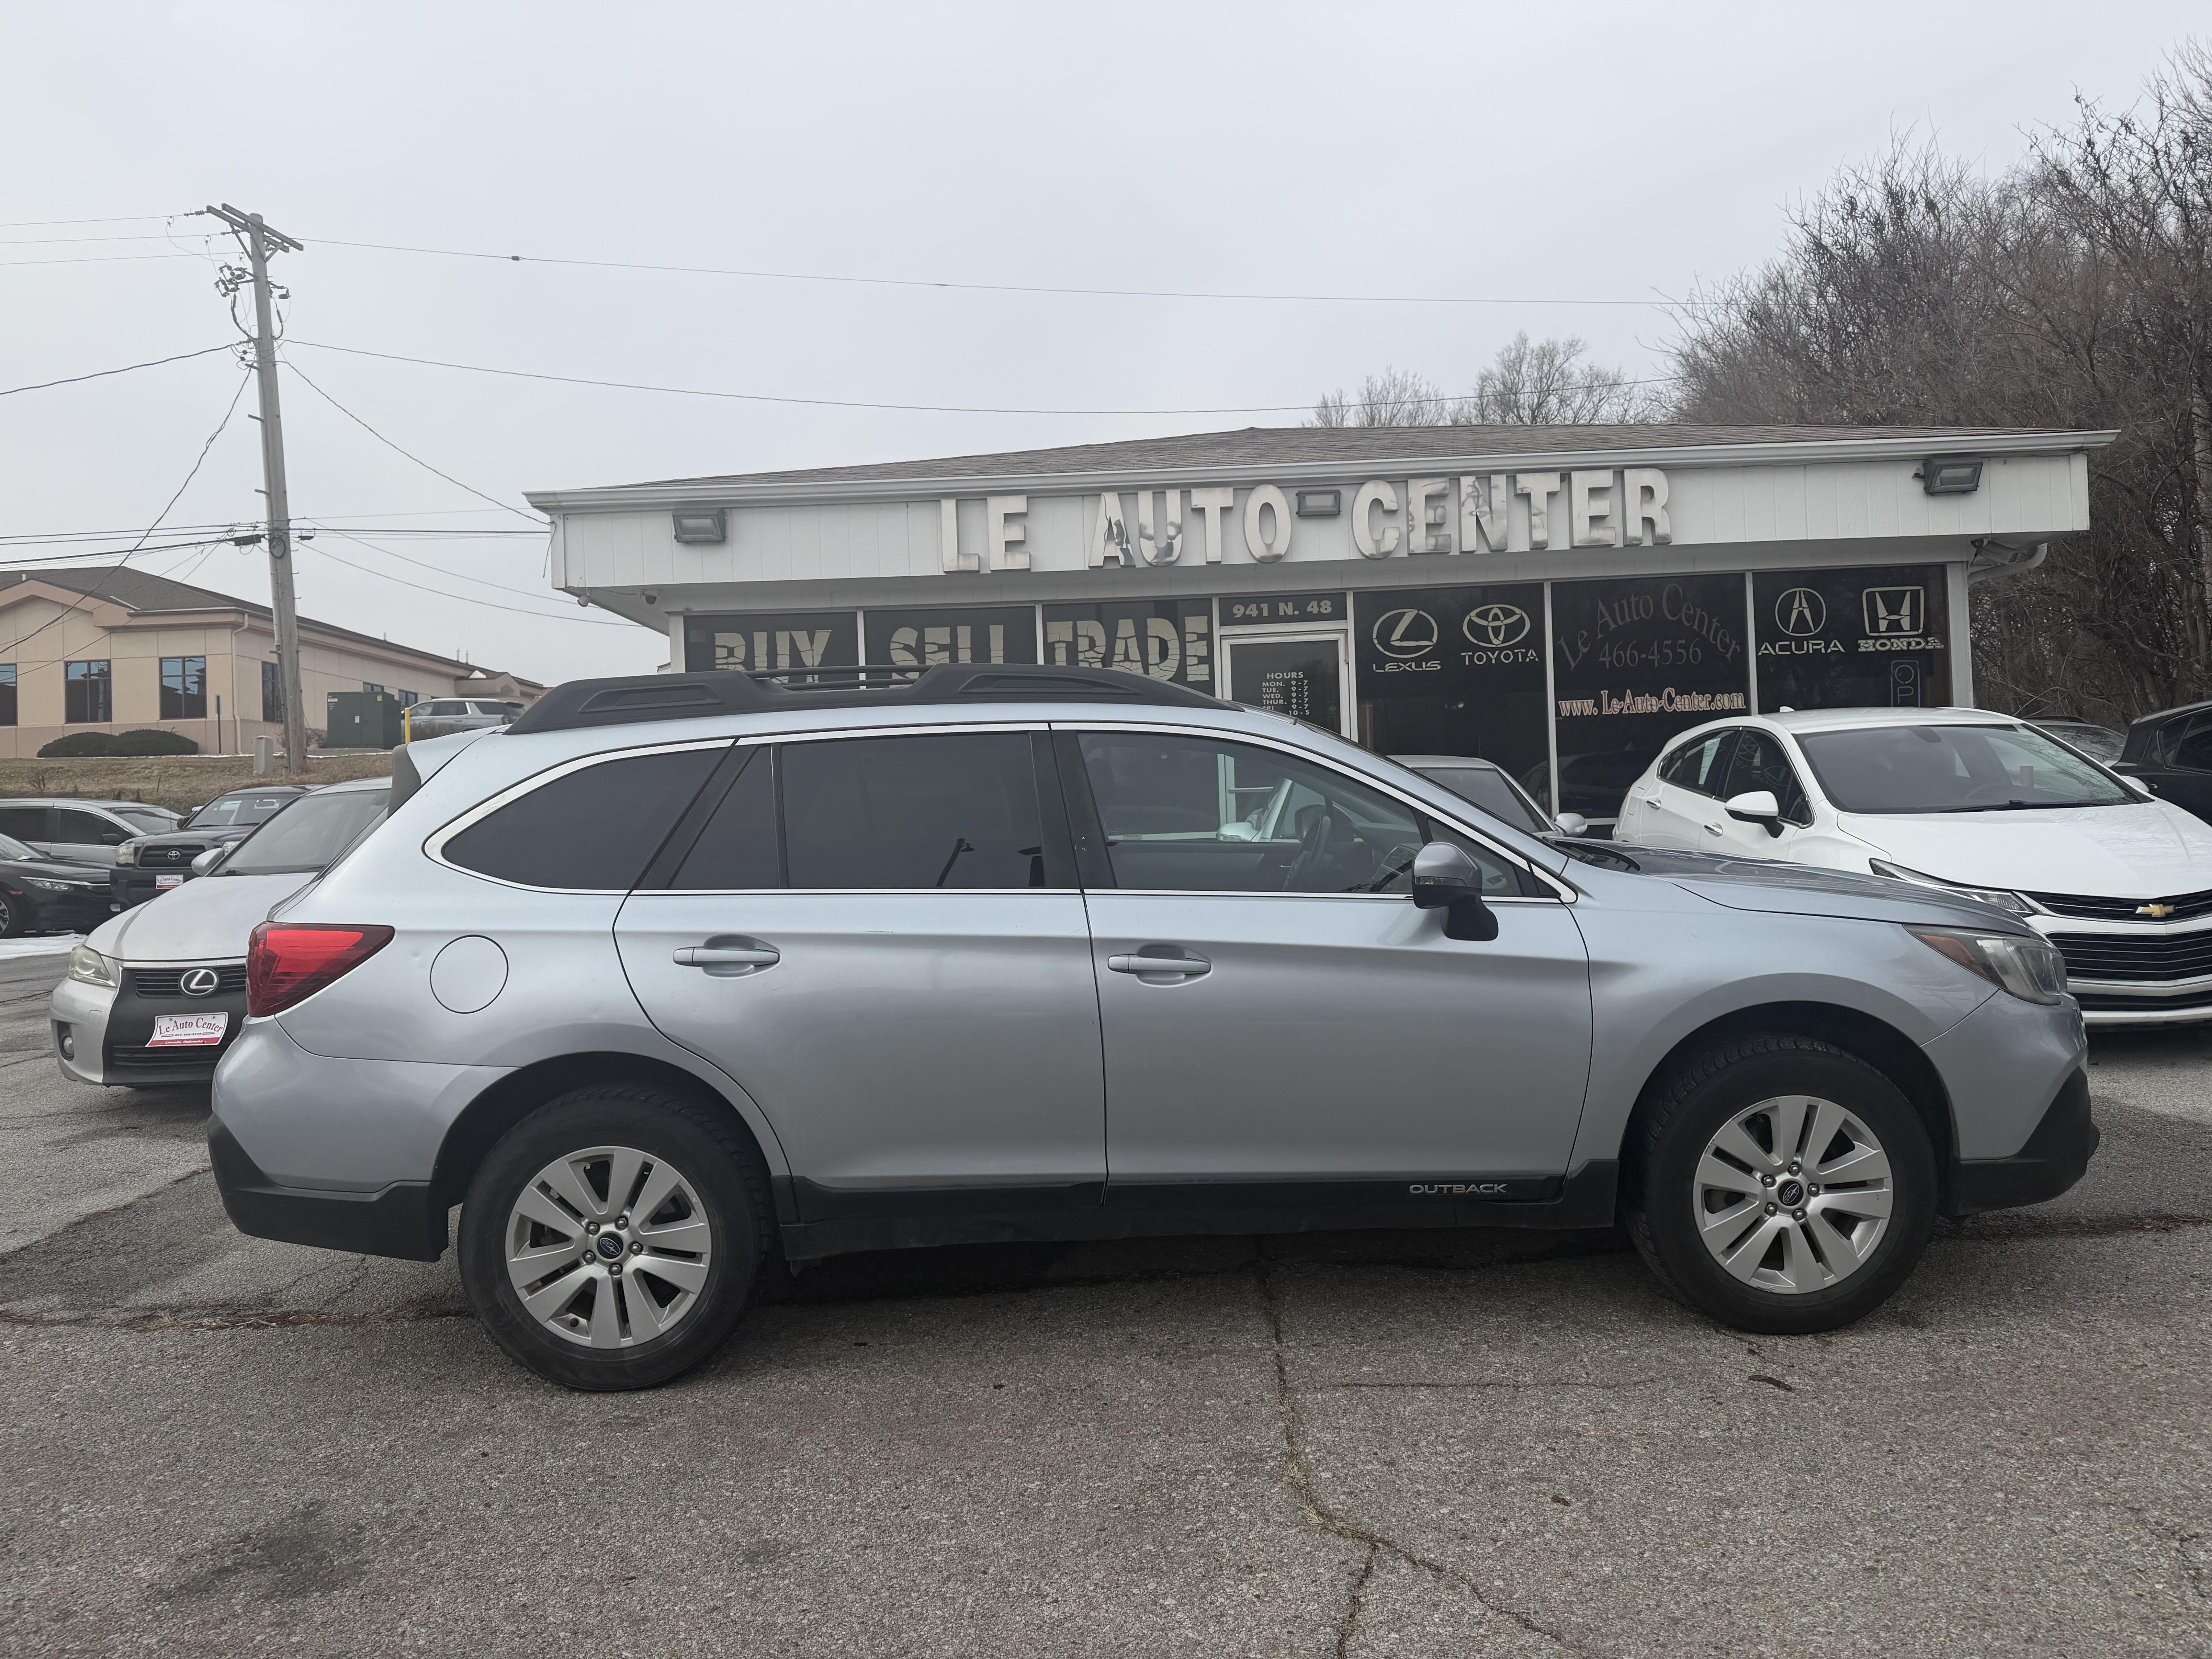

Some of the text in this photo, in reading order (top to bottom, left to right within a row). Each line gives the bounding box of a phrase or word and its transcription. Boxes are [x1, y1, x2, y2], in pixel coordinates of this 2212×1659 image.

[940, 467, 1673, 573] LE AUTO CENTER
[1233, 600, 1332, 618] 941 N. 48
[1557, 582, 1741, 671] Le Auto Center
[1046, 615, 1210, 682] TRADE
[1598, 638, 1702, 669] 466-4556
[1757, 639, 1846, 656] ACURA
[1858, 637, 1945, 653] HONDA
[1372, 660, 1441, 672] LEXUS
[1461, 649, 1539, 665] TOYOTA
[1558, 687, 1746, 716] www. Le-Auto-Center.com
[158, 1017, 223, 1035] Le Auto Center
[1409, 1184, 1507, 1194] OUTBACK
